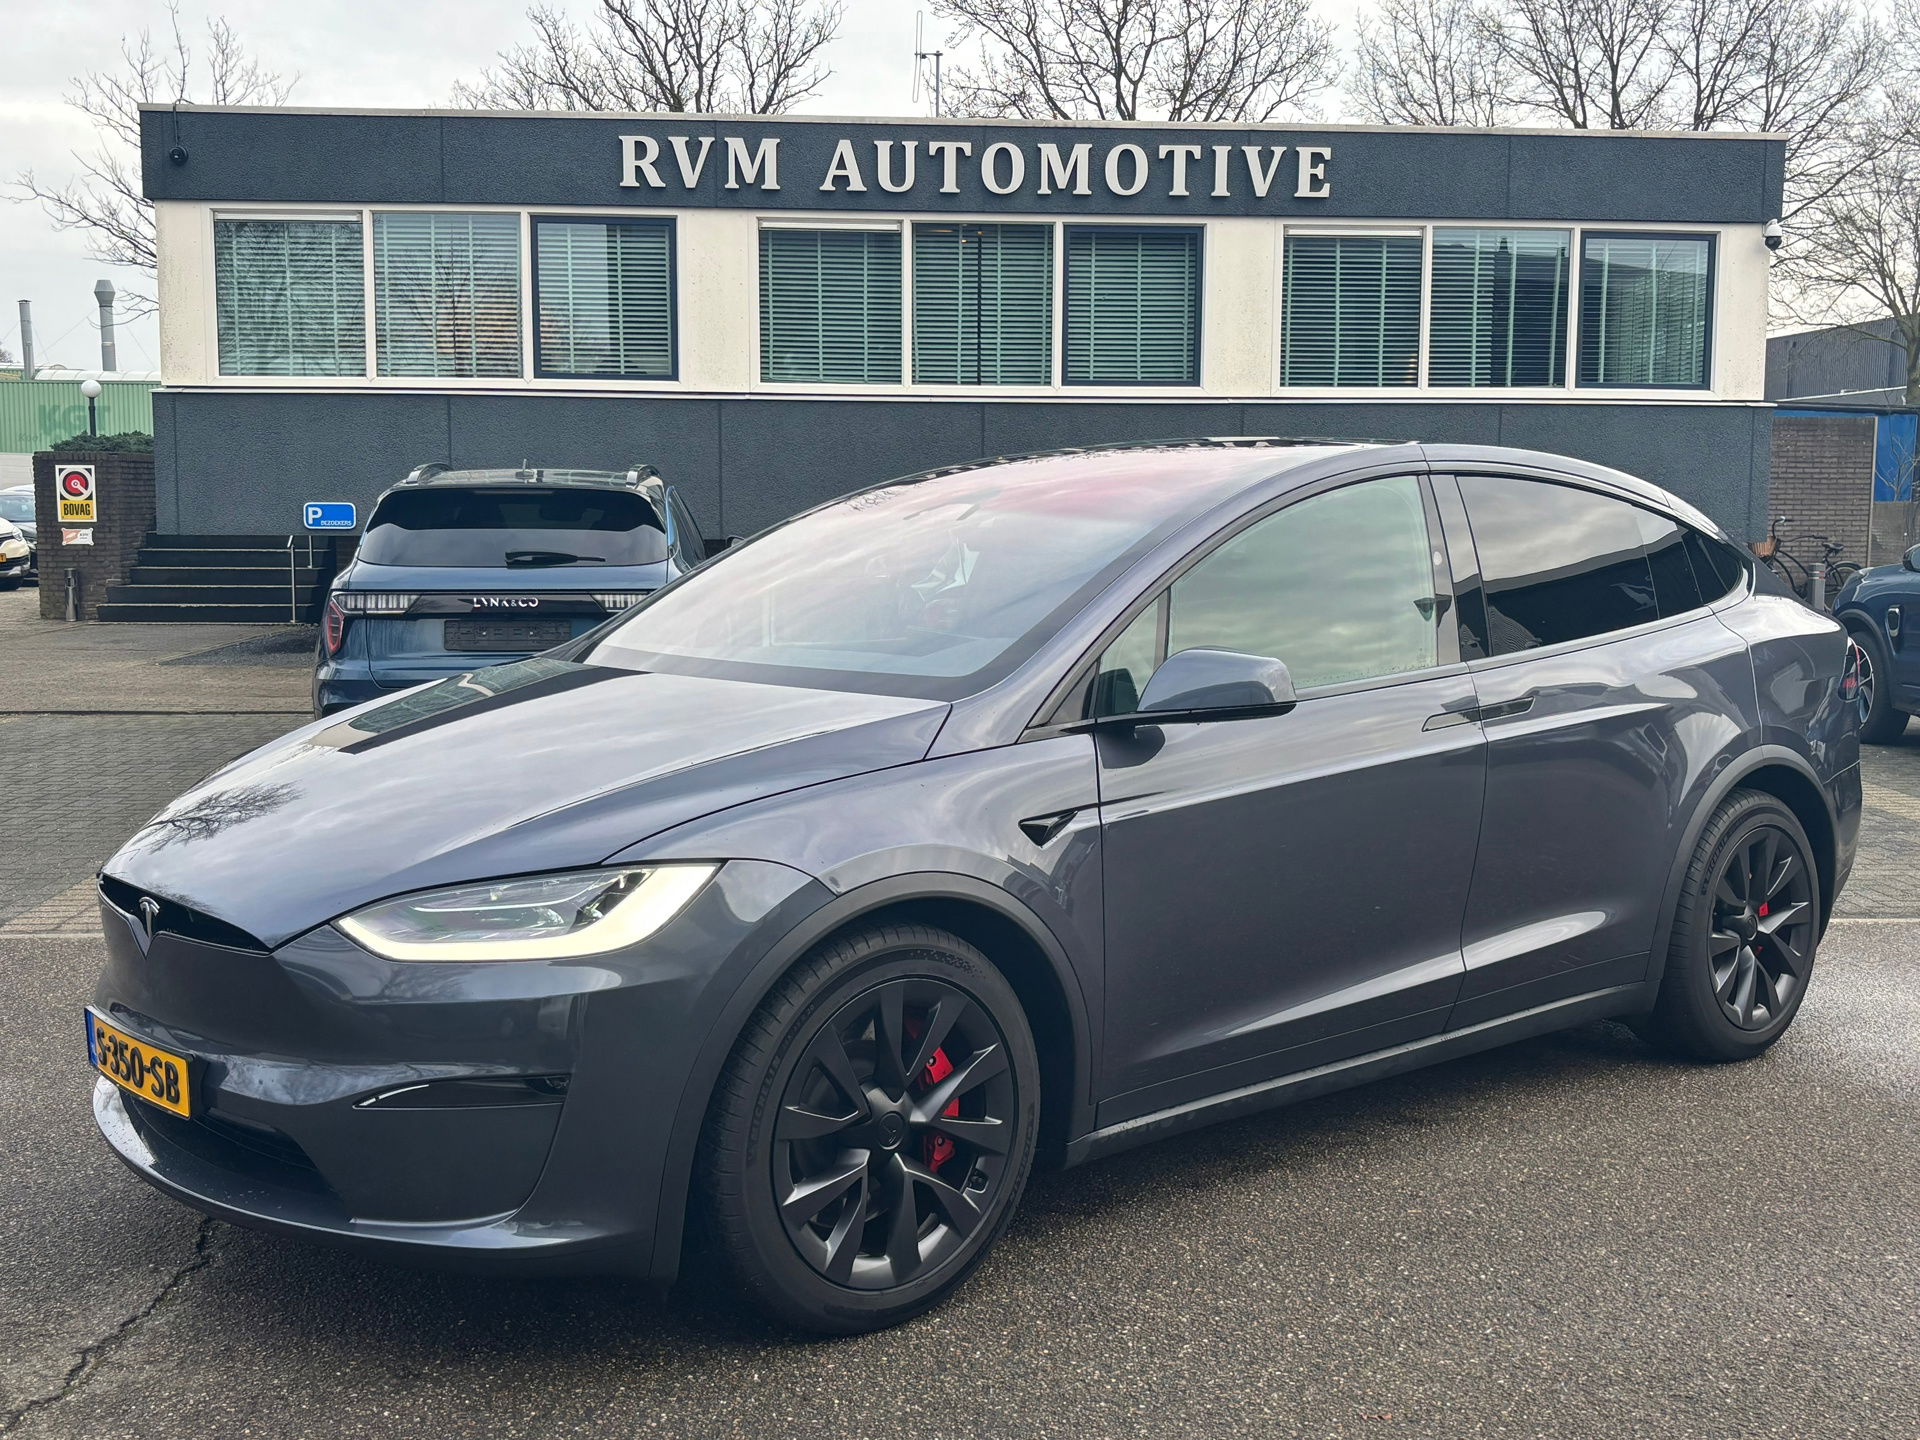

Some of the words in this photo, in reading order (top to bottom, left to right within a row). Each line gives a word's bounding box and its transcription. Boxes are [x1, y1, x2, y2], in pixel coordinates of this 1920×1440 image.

[619, 135, 781, 190] RVM
[819, 139, 1332, 198] AUTOMOTIVE
[63, 503, 91, 516] BOVAG
[308, 506, 322, 525] P
[96, 1026, 180, 1105] S-350-SB
